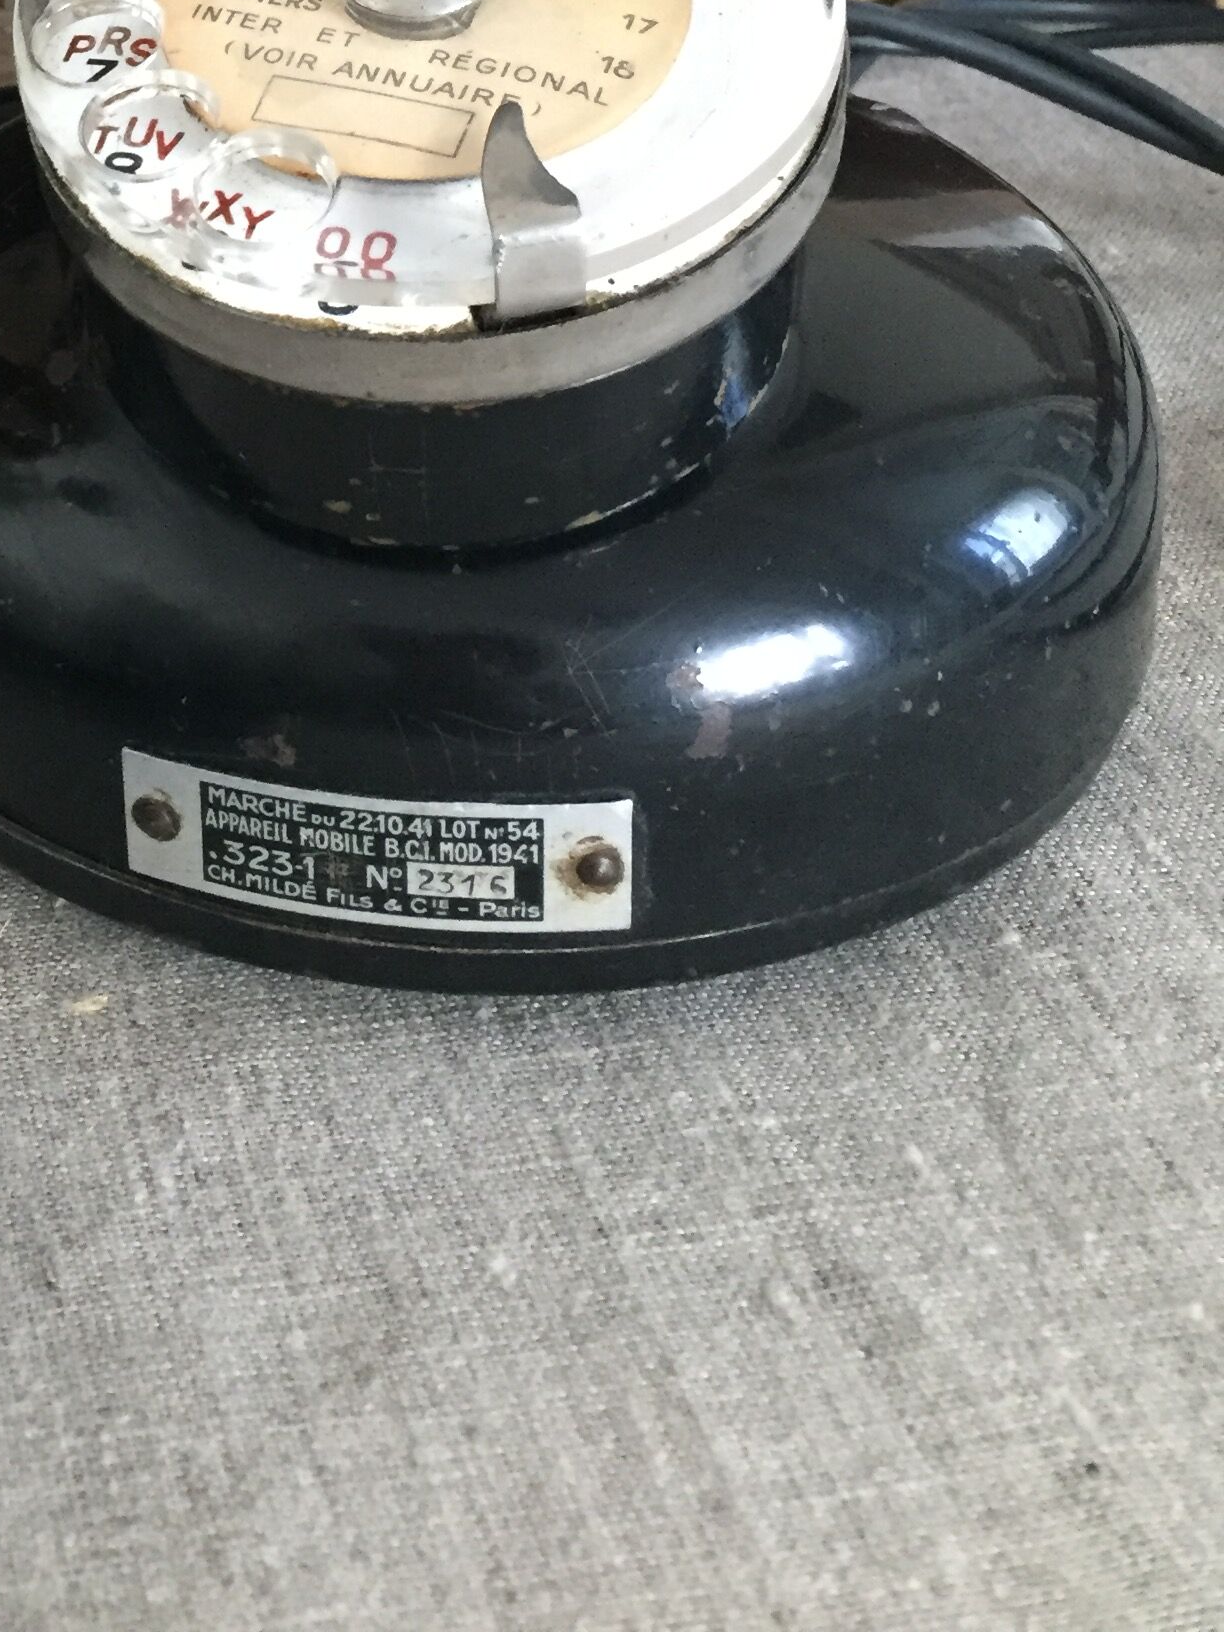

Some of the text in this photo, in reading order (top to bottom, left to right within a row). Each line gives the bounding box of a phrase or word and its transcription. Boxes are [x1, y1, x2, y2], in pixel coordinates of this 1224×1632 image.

[623, 13, 659, 34] 17
[63, 26, 157, 66] PRS
[191, 4, 609, 107] INTER ET RÉGIONAL
[86, 58, 119, 83] 7
[601, 55, 635, 80] 18
[94, 116, 185, 160] TUV
[205, 808, 293, 845] APPAREIL
[299, 826, 376, 857] MOBILE
[439, 841, 486, 863] MOD.
[488, 843, 539, 865] 1941
[439, 819, 480, 839] LOT
[507, 821, 540, 841] 54
[417, 867, 508, 897] 2316
